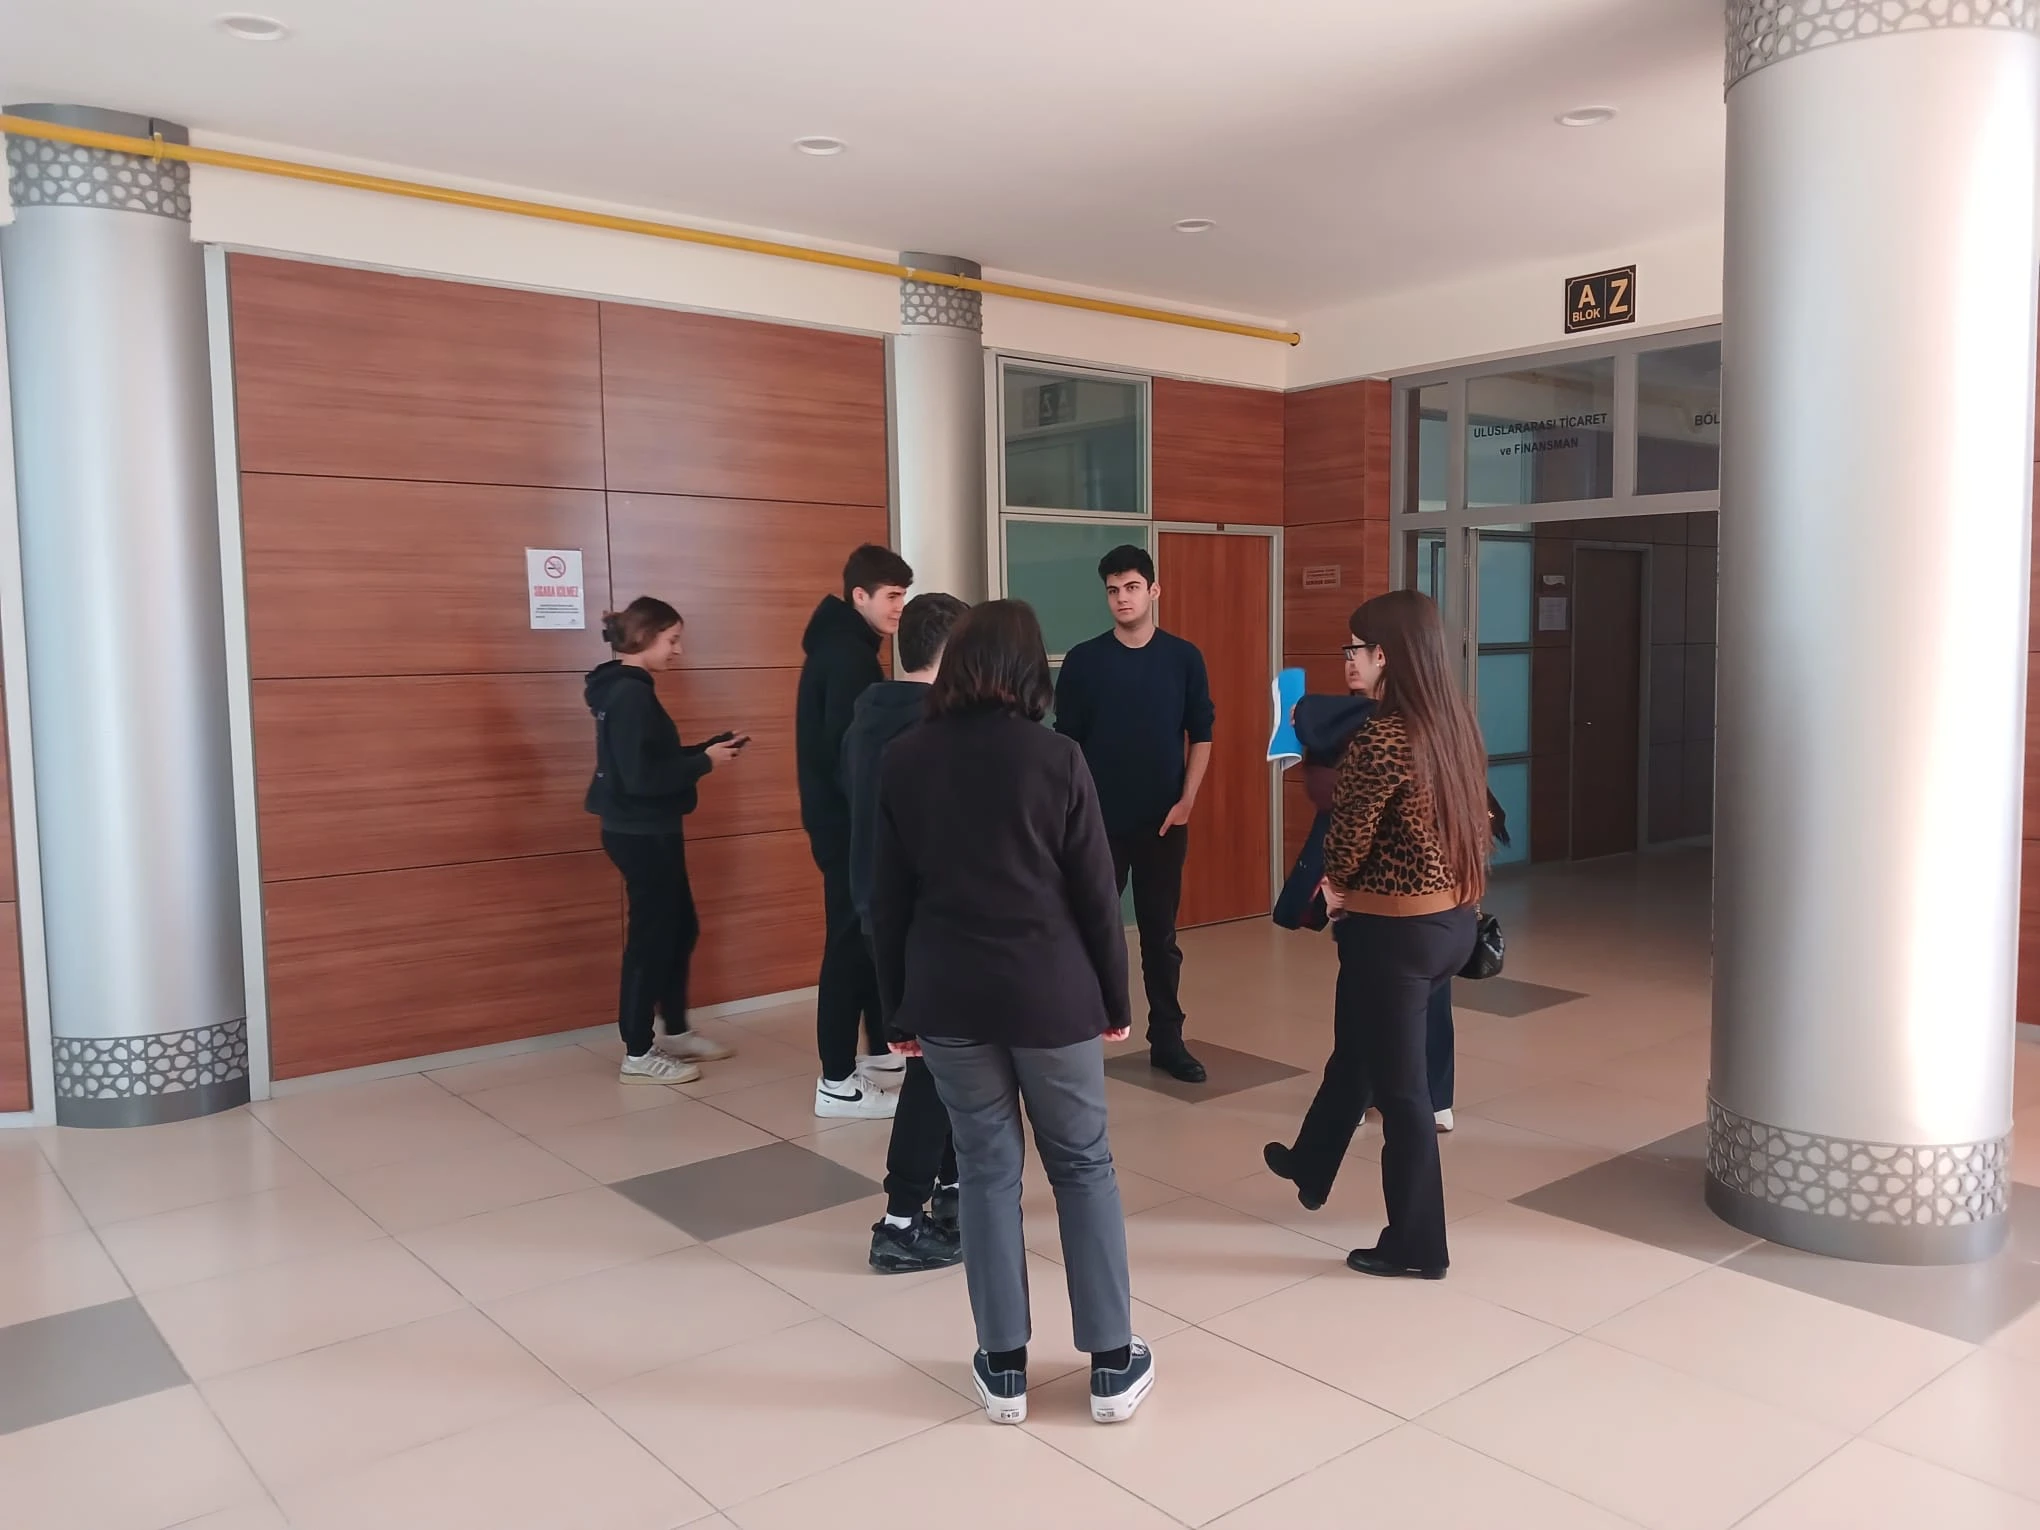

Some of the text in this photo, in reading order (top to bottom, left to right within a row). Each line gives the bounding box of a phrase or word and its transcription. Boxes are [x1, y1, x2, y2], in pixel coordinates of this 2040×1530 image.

[1578, 284, 1596, 309] A
[1609, 278, 1628, 315] Z
[1572, 308, 1601, 322] BLOK
[1474, 412, 1608, 438] ULUSLARARASI TİCARET
[1500, 437, 1579, 456] ve FİNANSMAN
